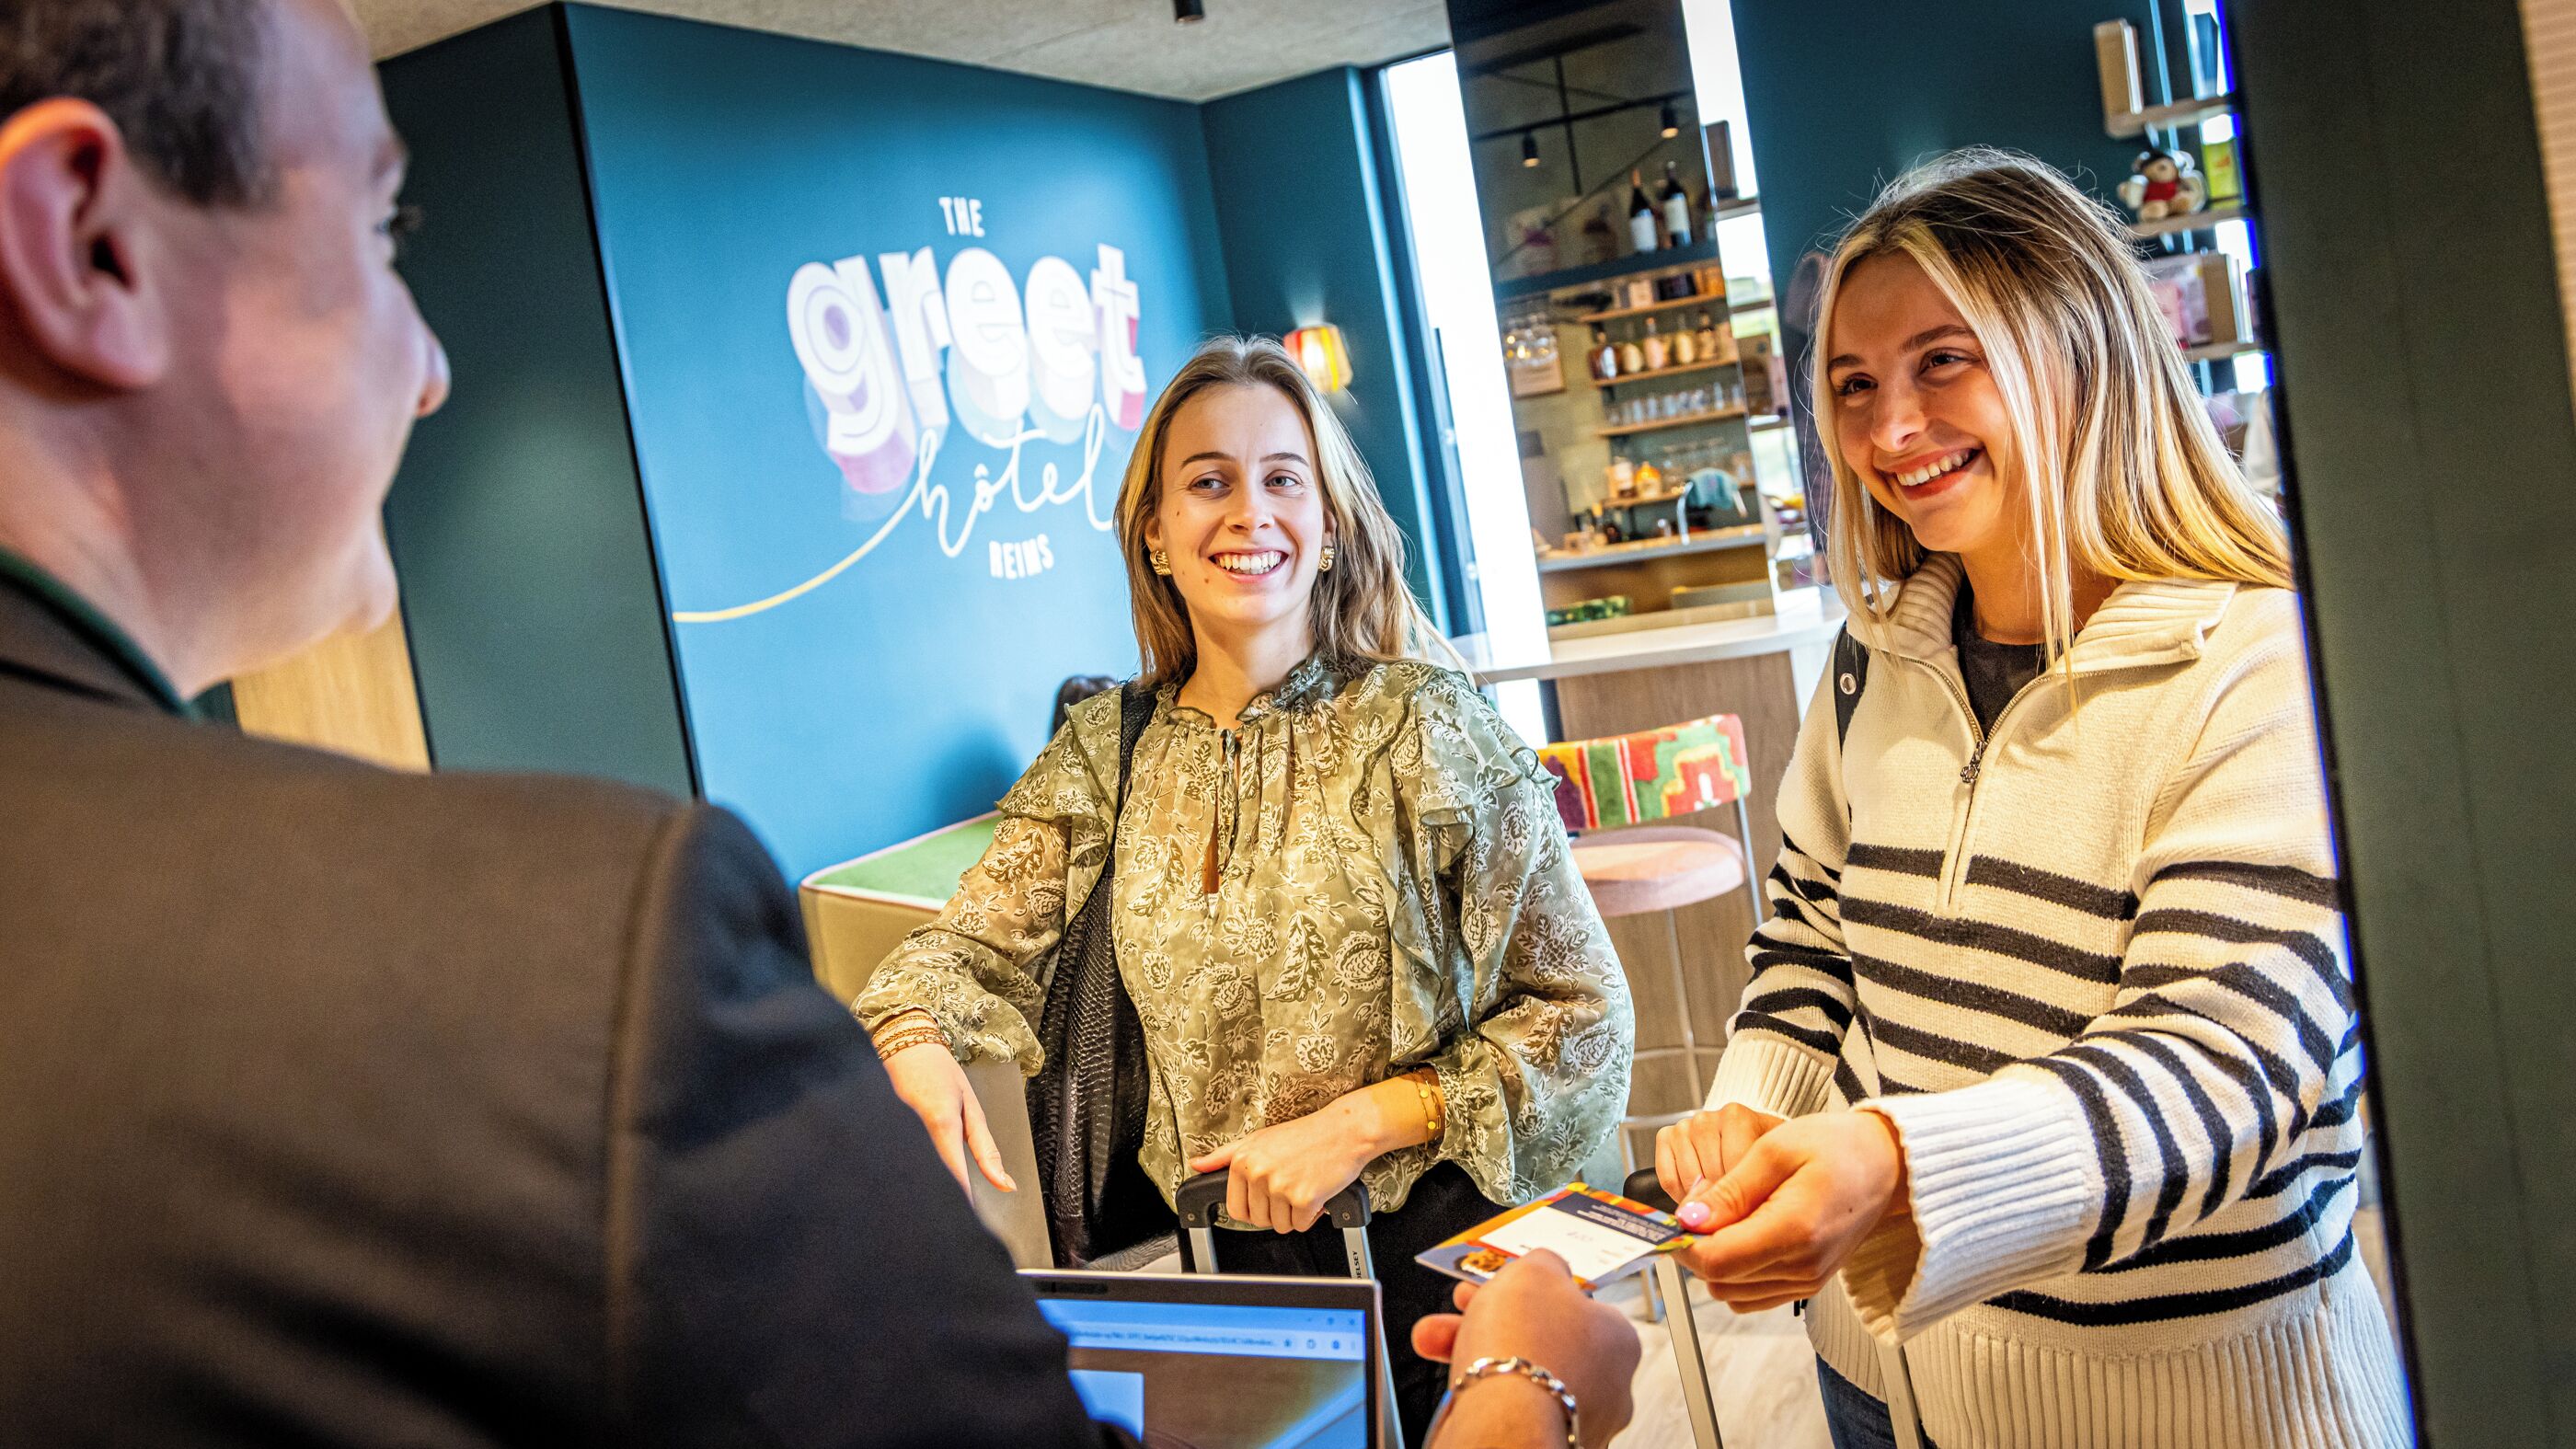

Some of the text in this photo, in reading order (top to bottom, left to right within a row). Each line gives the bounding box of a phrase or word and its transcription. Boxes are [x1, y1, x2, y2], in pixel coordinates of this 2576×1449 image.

[937, 196, 985, 237] THE
[787, 243, 1148, 460] greet
[918, 403, 1115, 558] hôtel
[988, 534, 1055, 581] REIMS
